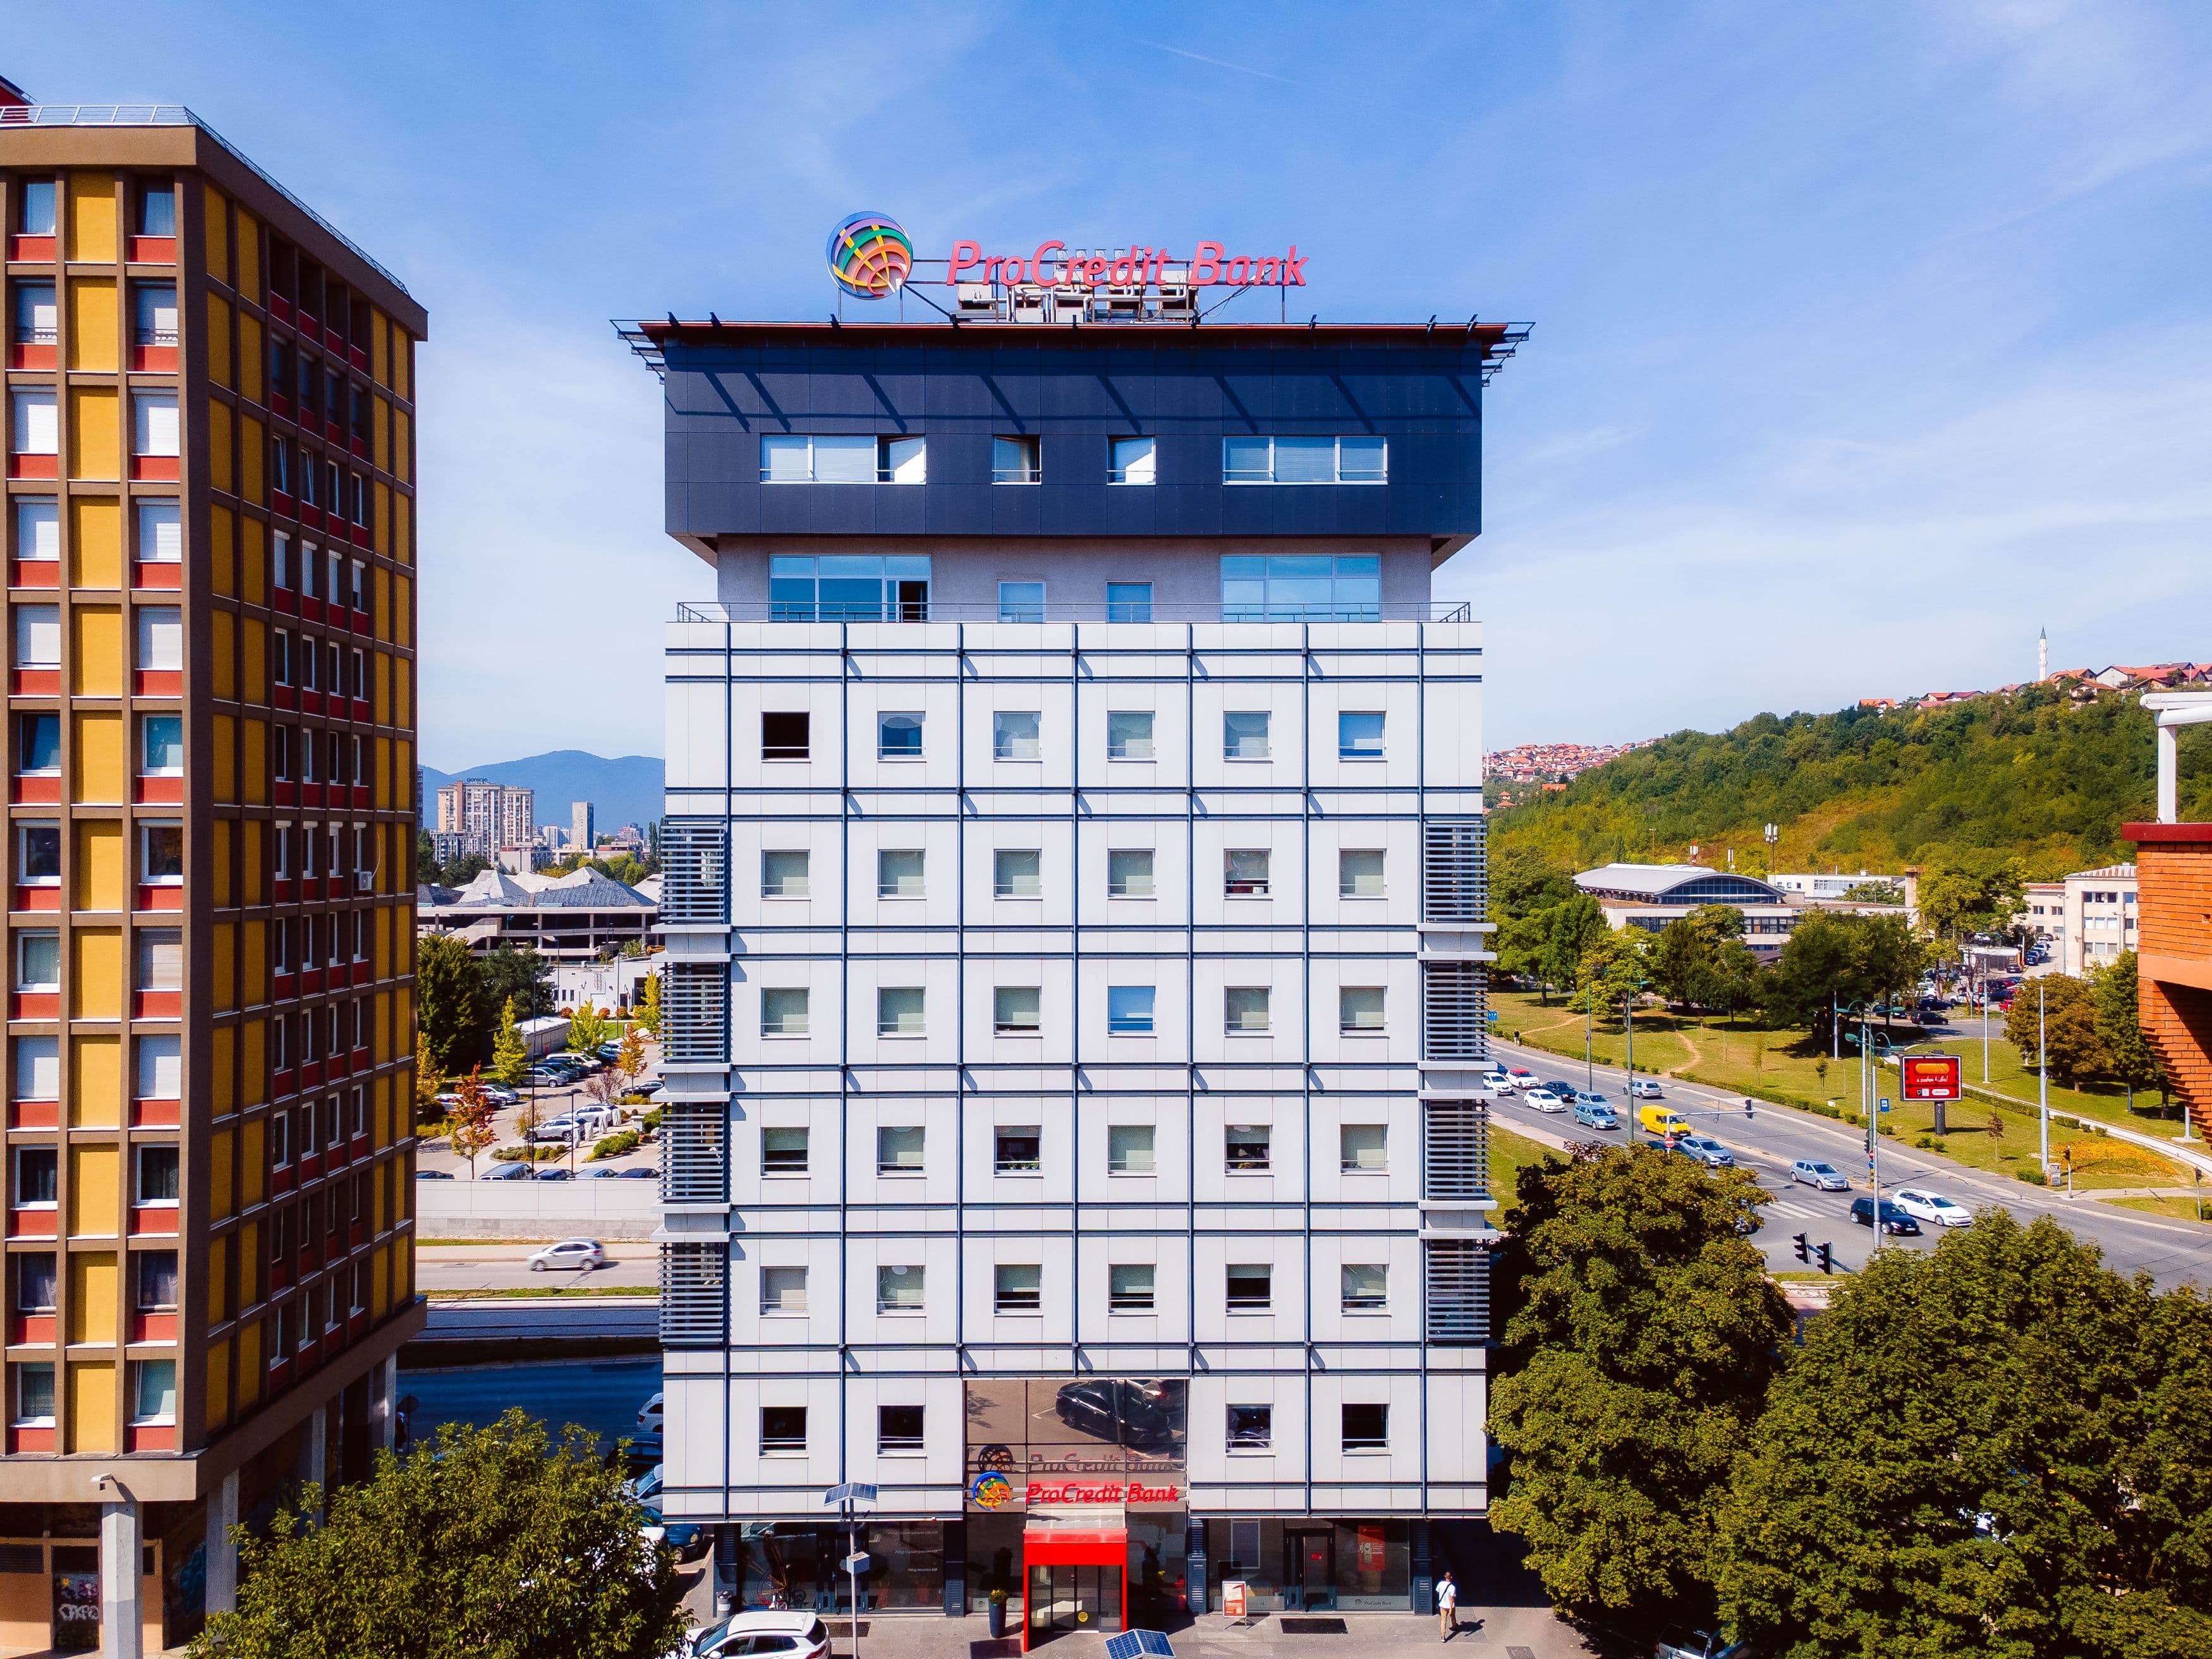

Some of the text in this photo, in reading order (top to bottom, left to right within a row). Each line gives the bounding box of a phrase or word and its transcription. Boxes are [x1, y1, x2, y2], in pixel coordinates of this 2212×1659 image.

[946, 240, 1310, 287] ProCredit Bank
[1025, 1483, 1178, 1504] ProCredit Bank
